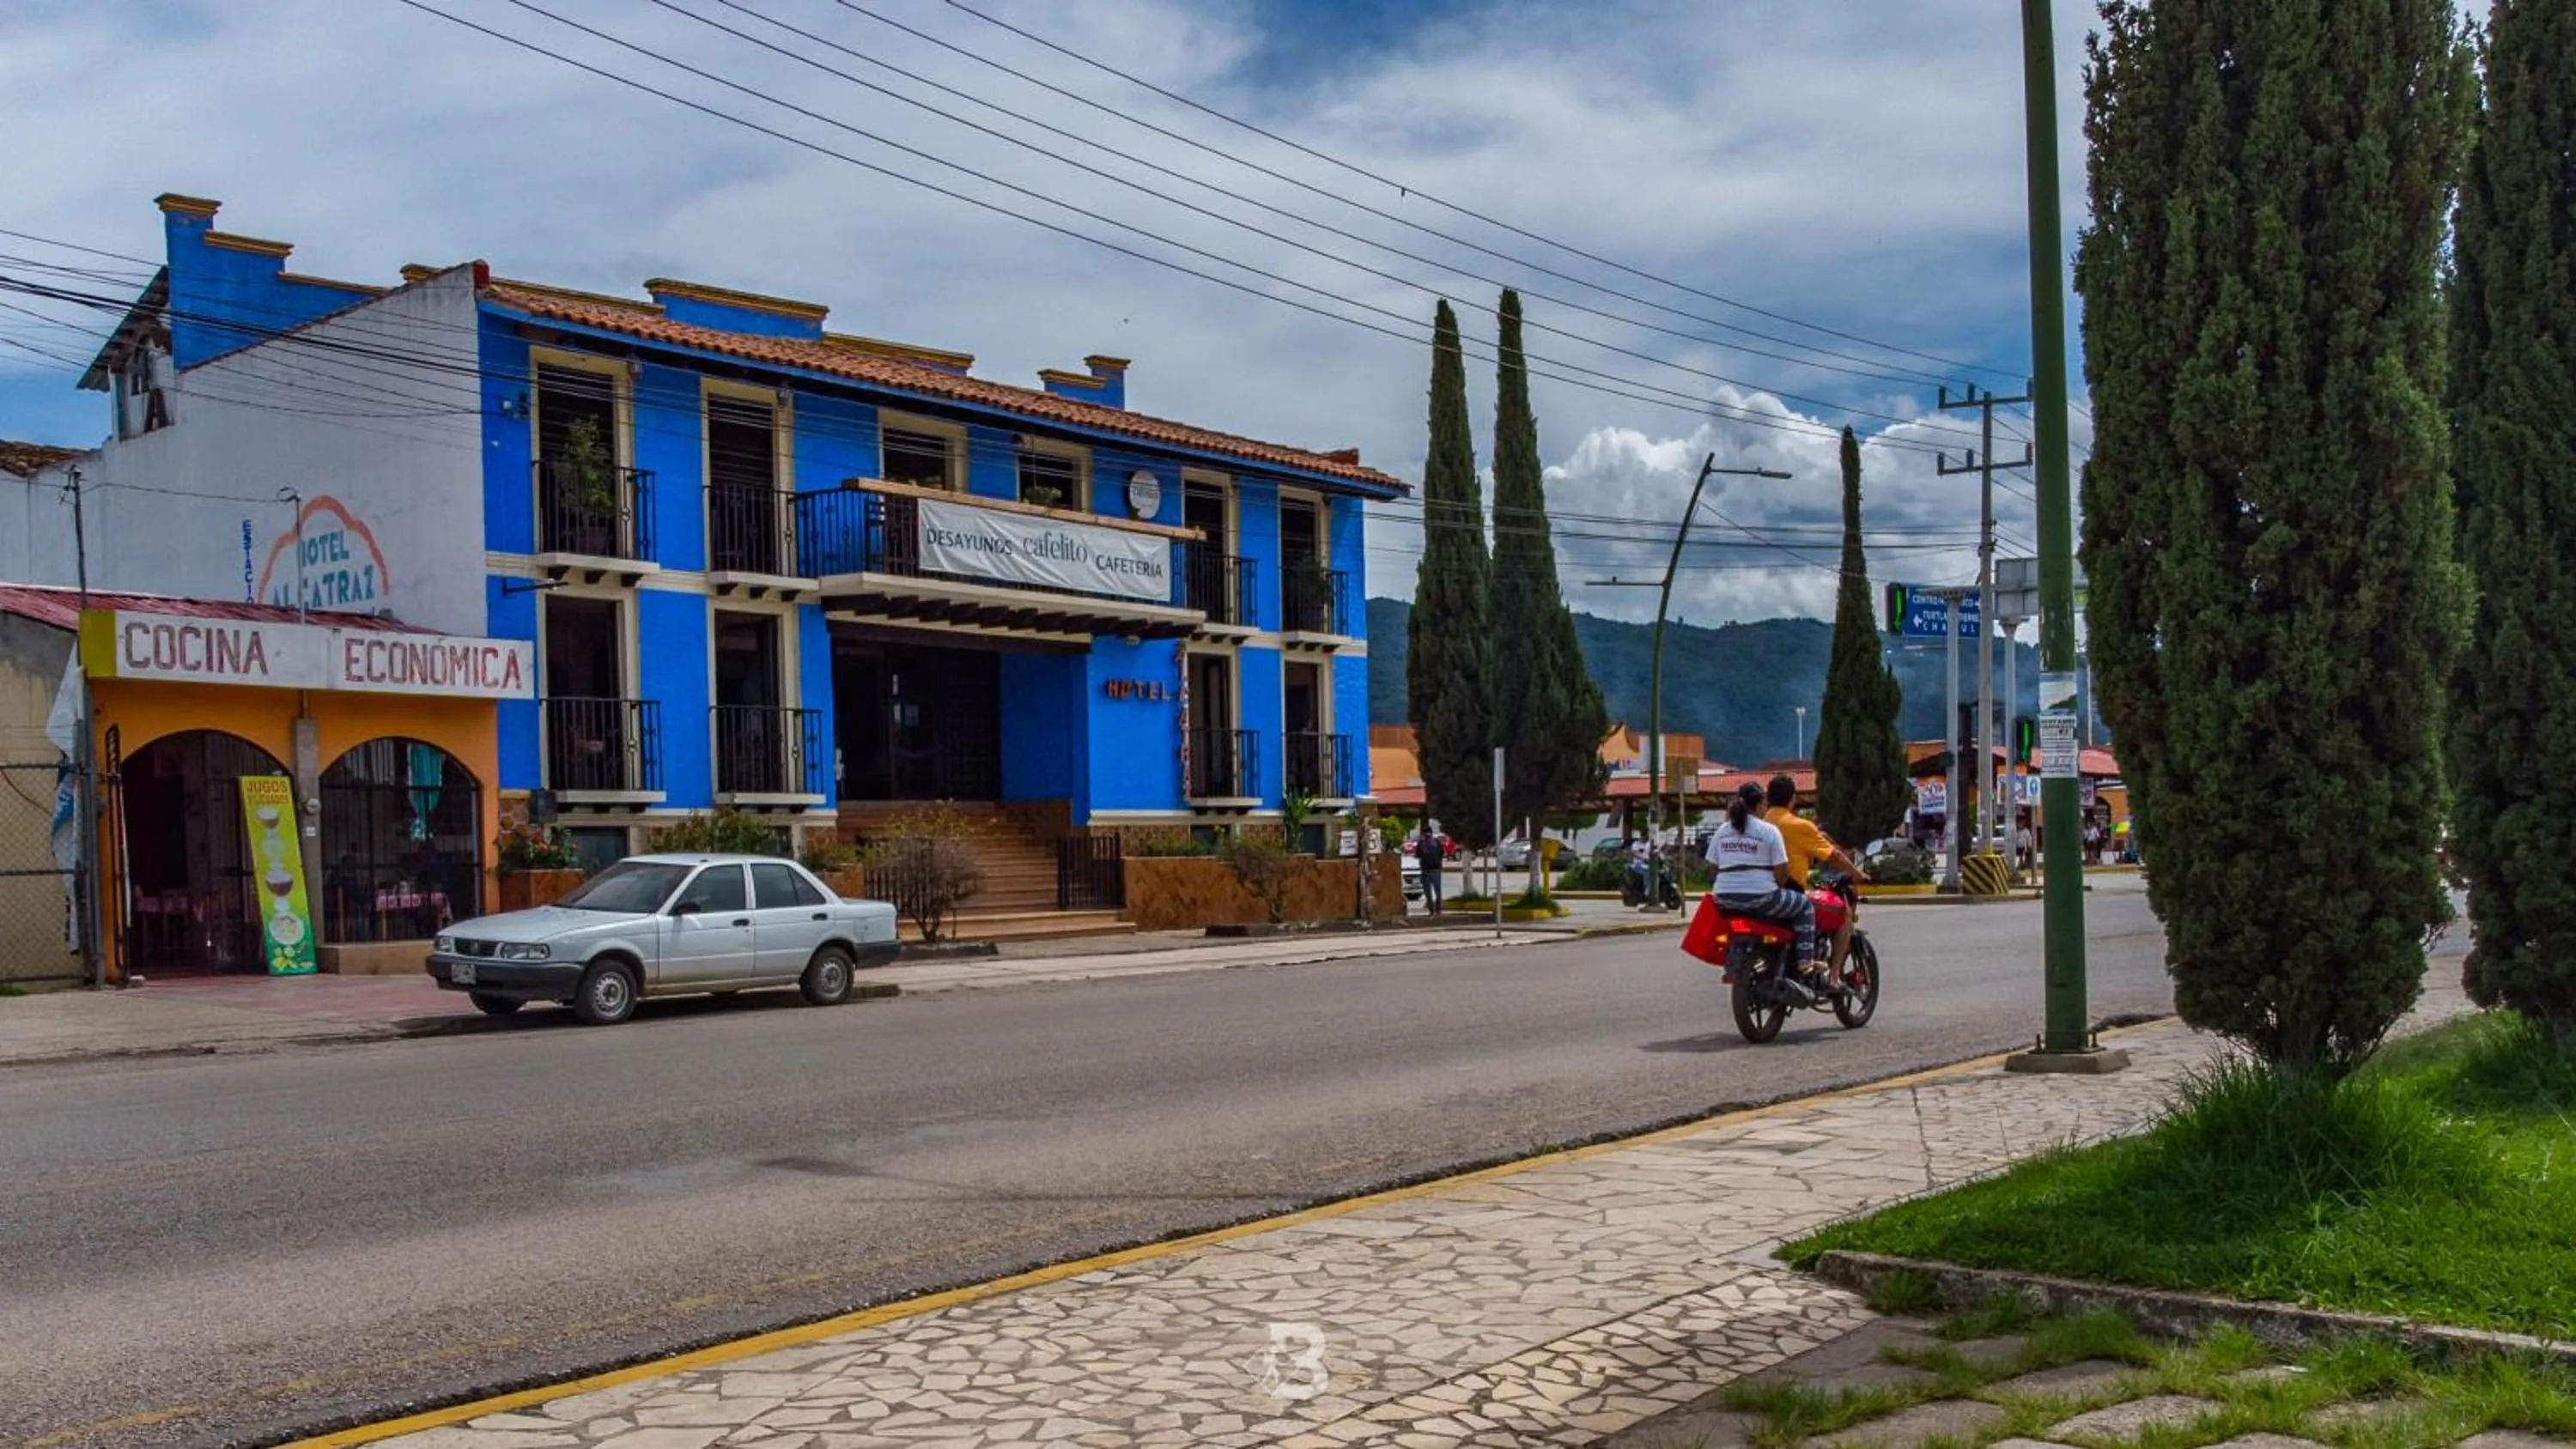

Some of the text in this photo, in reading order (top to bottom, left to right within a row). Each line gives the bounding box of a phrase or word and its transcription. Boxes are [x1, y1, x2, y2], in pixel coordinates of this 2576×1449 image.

[927, 528, 1013, 555] DESAYUNOS
[1023, 530, 1088, 563] cafelito
[125, 621, 522, 689] COCINA ECONÓMICA
[1105, 679, 1170, 702] HOTEL
